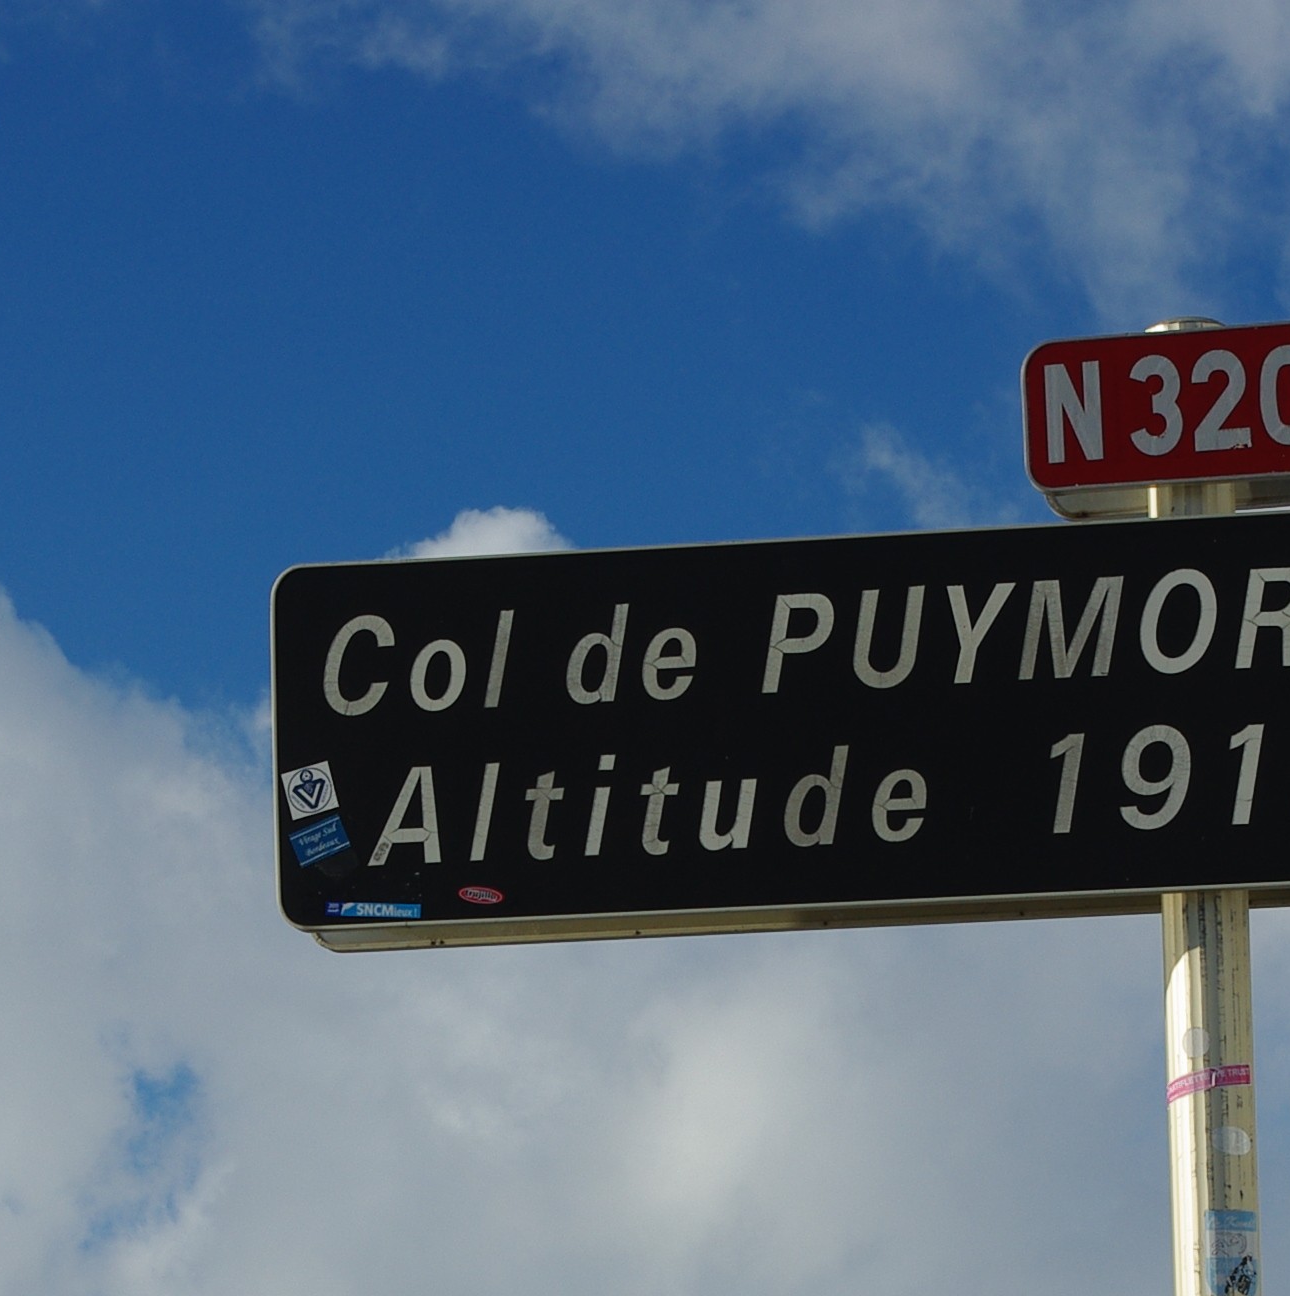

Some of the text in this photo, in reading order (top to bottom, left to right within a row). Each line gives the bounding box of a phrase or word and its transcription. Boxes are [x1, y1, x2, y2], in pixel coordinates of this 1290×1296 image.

[1044, 360, 1104, 464] N
[323, 609, 515, 717] Col
[566, 603, 697, 705] de
[368, 744, 927, 867] Altitude
